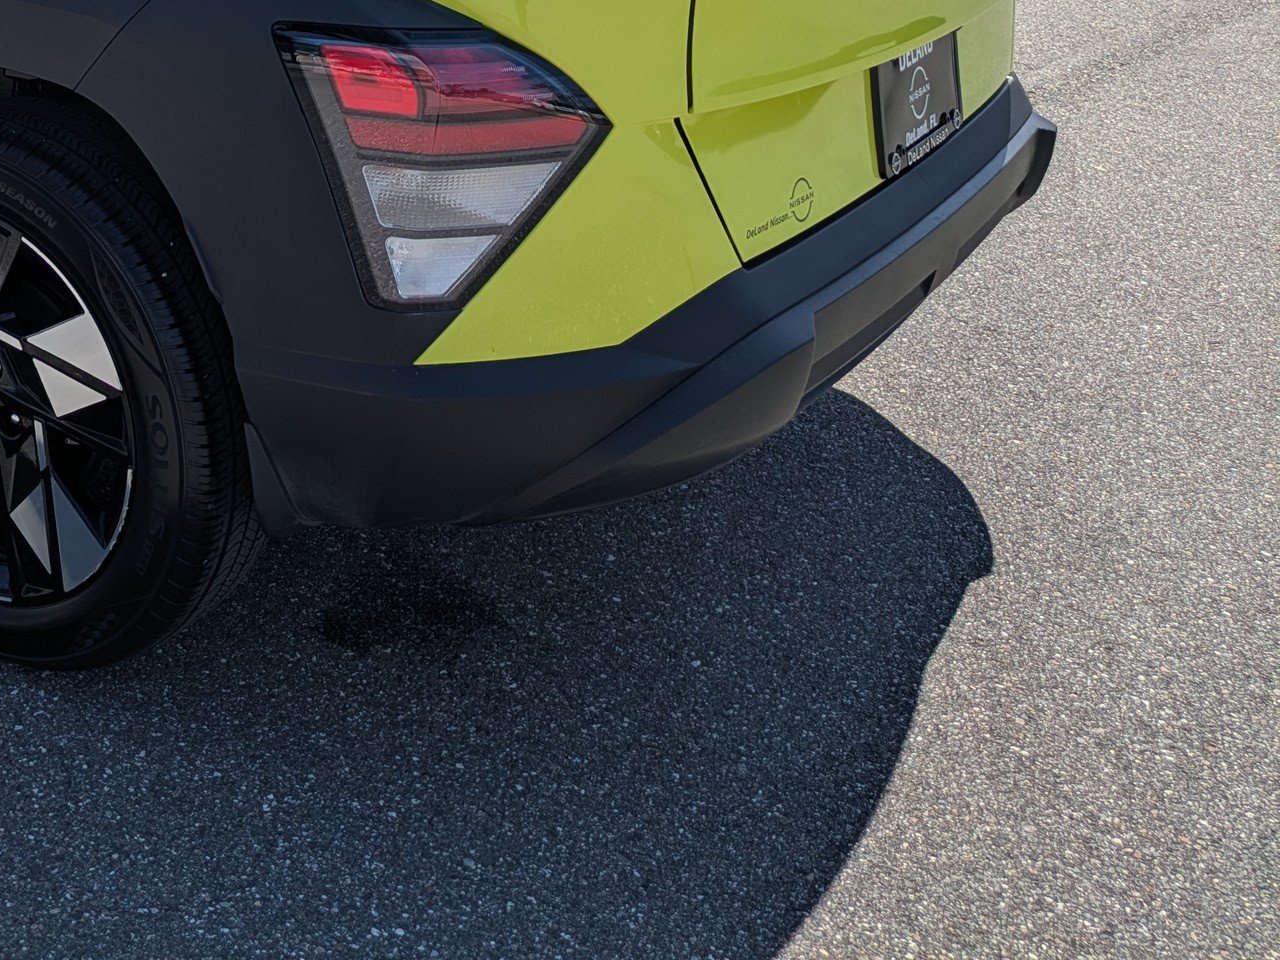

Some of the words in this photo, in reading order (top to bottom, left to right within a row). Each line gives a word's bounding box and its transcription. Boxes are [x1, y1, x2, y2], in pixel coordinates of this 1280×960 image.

[898, 41, 934, 72] DELAND
[909, 82, 931, 103] NISSAN
[905, 119, 929, 146] DeLand,
[929, 113, 938, 129] FL
[907, 140, 931, 165] DeLand
[930, 128, 949, 149] Nissan
[789, 190, 814, 209] NISSAN
[746, 220, 769, 239] DeLand
